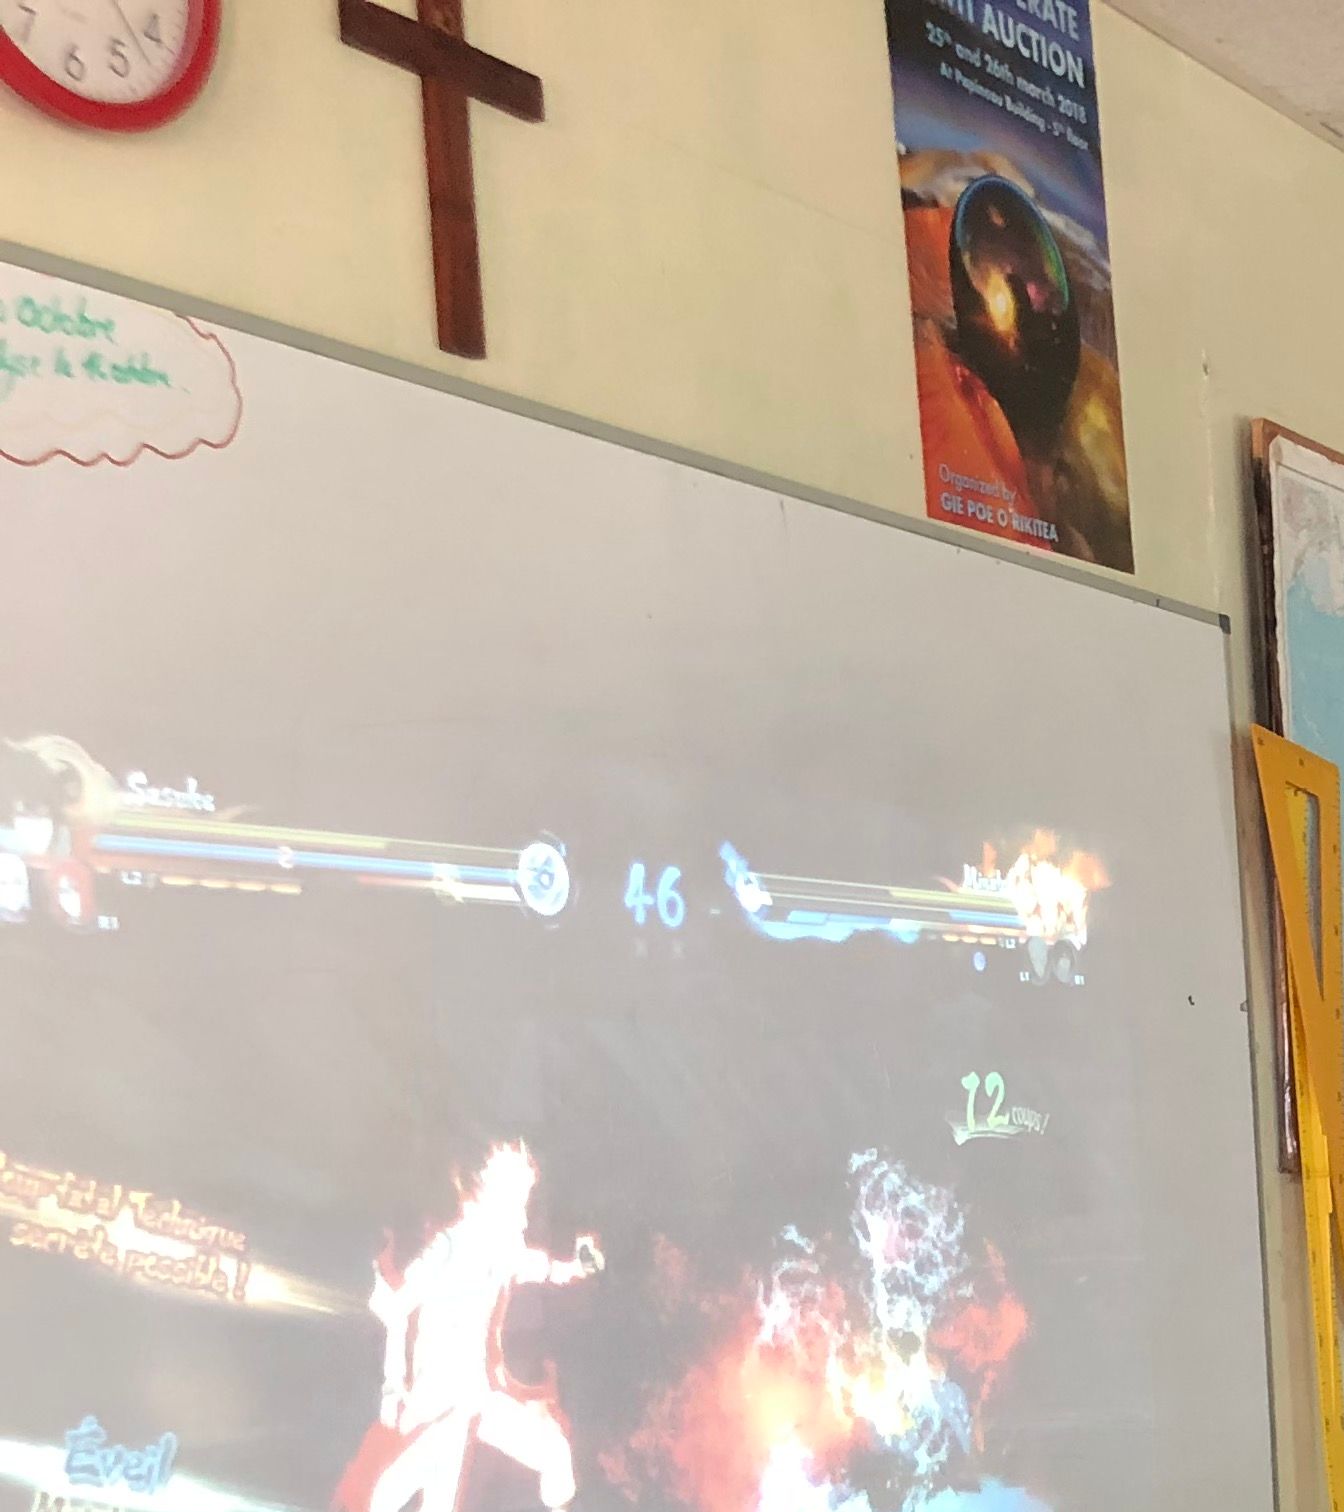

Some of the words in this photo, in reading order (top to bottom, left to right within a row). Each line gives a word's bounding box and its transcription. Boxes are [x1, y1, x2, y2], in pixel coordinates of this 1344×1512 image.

[64, 44, 86, 81] 6
[108, 38, 129, 78] 5
[982, 4, 1085, 88] AUCTION
[940, 464, 999, 497] Organized
[942, 492, 964, 514] GIE
[968, 500, 993, 523] POE
[997, 508, 1007, 527] O
[1012, 512, 1059, 542] RIKITEA
[623, 862, 686, 929] 46
[961, 1071, 1009, 1134] 12
